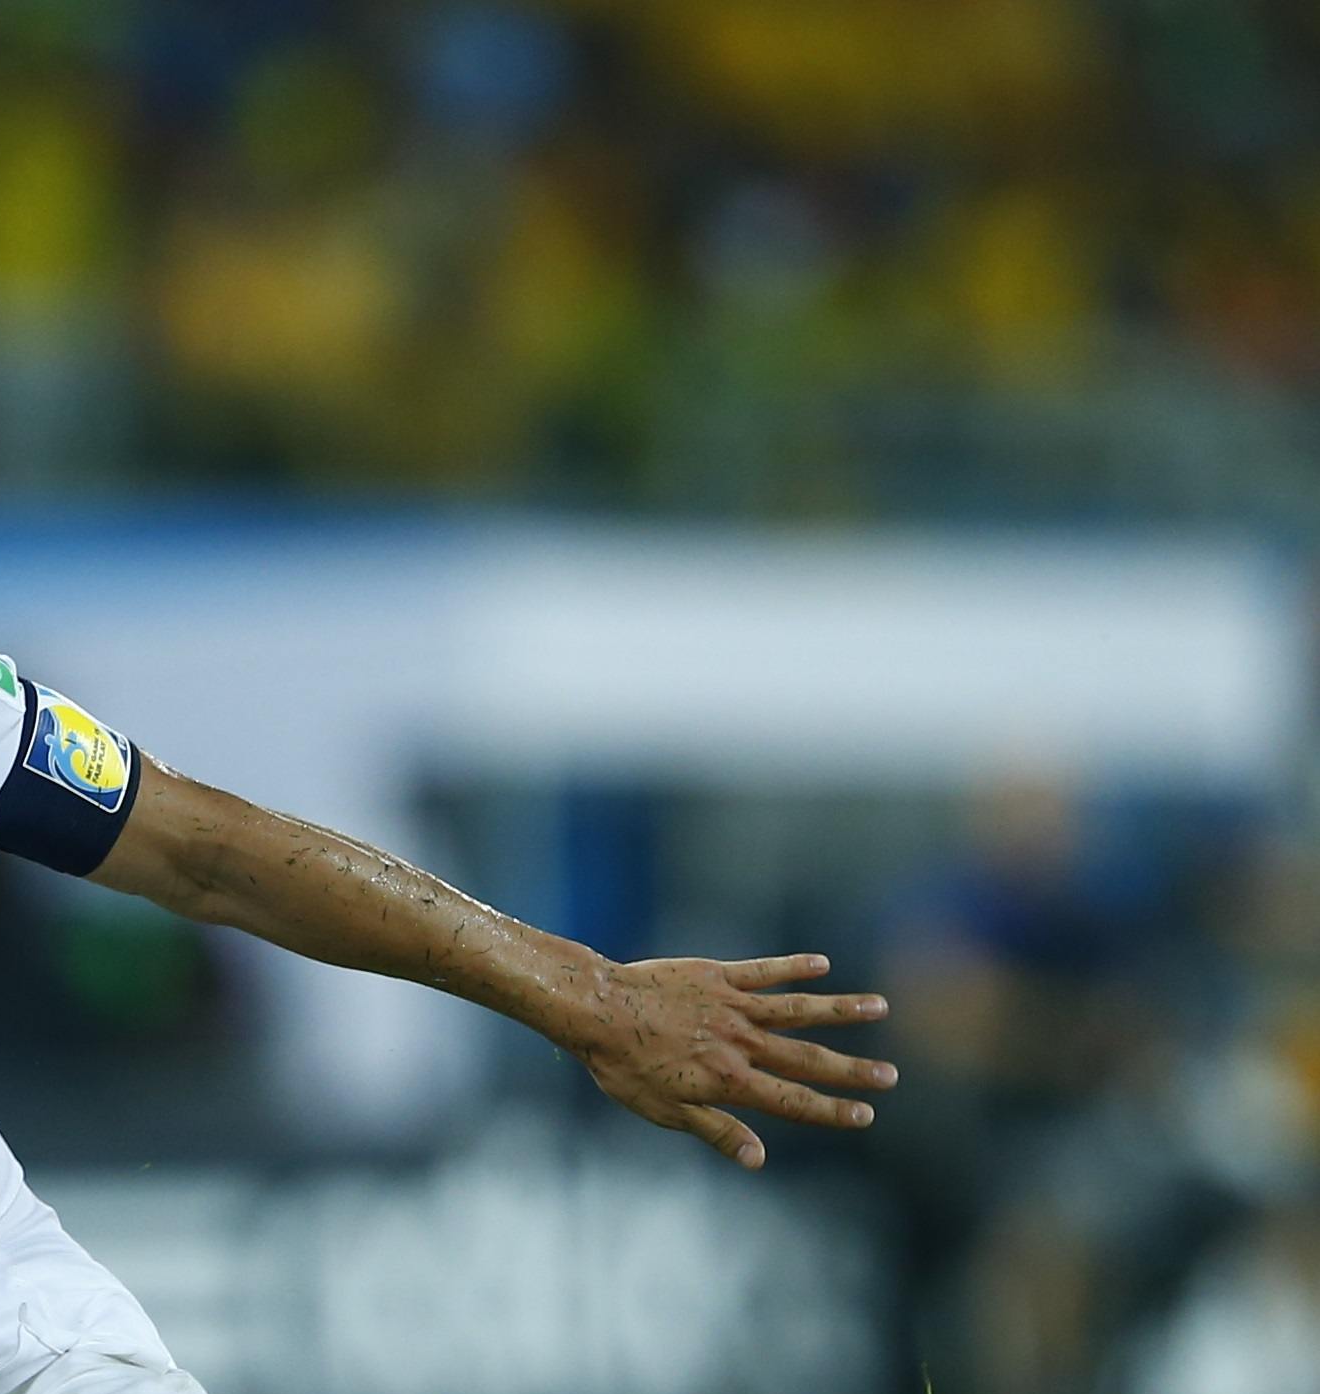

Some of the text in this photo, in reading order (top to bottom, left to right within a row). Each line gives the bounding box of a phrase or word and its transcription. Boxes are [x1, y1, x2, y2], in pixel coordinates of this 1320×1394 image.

[86, 763, 94, 779] MY
[92, 741, 106, 784] FAIR PLAY
